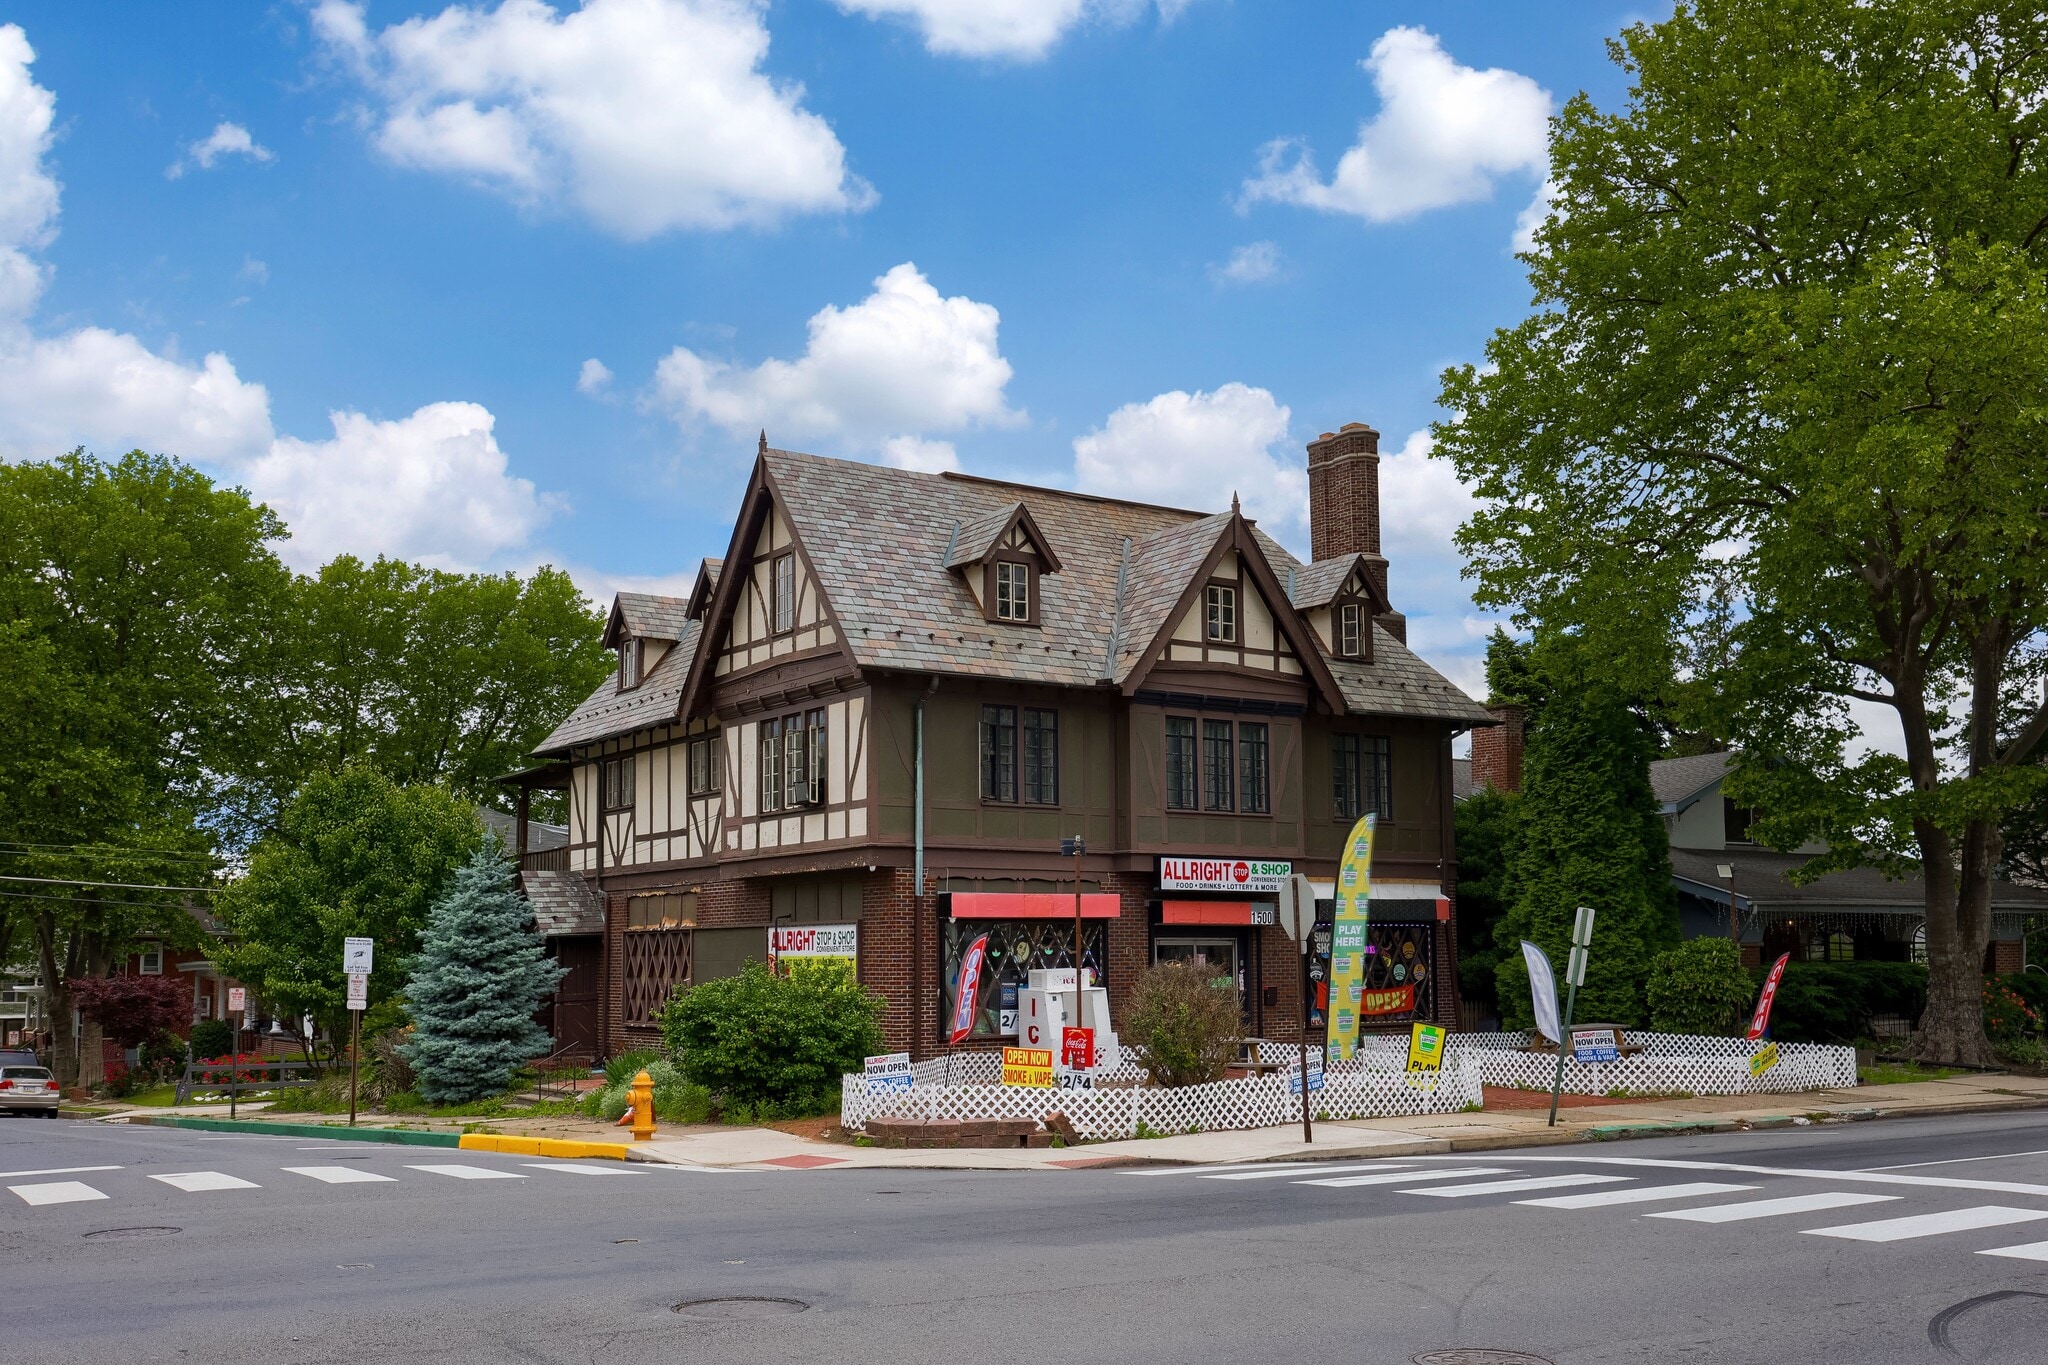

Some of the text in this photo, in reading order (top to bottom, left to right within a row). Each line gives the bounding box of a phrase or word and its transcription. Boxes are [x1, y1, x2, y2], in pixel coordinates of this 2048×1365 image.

[1163, 861, 1290, 881] ALLRIGHT STOP & SHOP
[1199, 882, 1222, 890] DRINKS
[1252, 911, 1272, 924] 1500
[1338, 925, 1362, 935] PLAY
[771, 930, 855, 952] ALLRIGHT STOP & SHOP
[1314, 932, 1330, 943] SMO
[1335, 937, 1363, 947] HERE!
[816, 945, 841, 953] CONVENIENT
[956, 949, 981, 1031] OPEN
[1366, 990, 1408, 1012] OPEN!
[1065, 1037, 1088, 1049] Coca-Cola
[1575, 1039, 1594, 1047] NOW
[1594, 1037, 1614, 1046] OPEN
[1007, 1049, 1049, 1066] OPEN NOW
[867, 1062, 908, 1075] NOW OPEN
[1411, 1060, 1437, 1072] PLAY
[1003, 1068, 1027, 1083] SMOKE
[1034, 1071, 1052, 1085] VAPE
[1063, 1075, 1092, 1091] 2/$4
